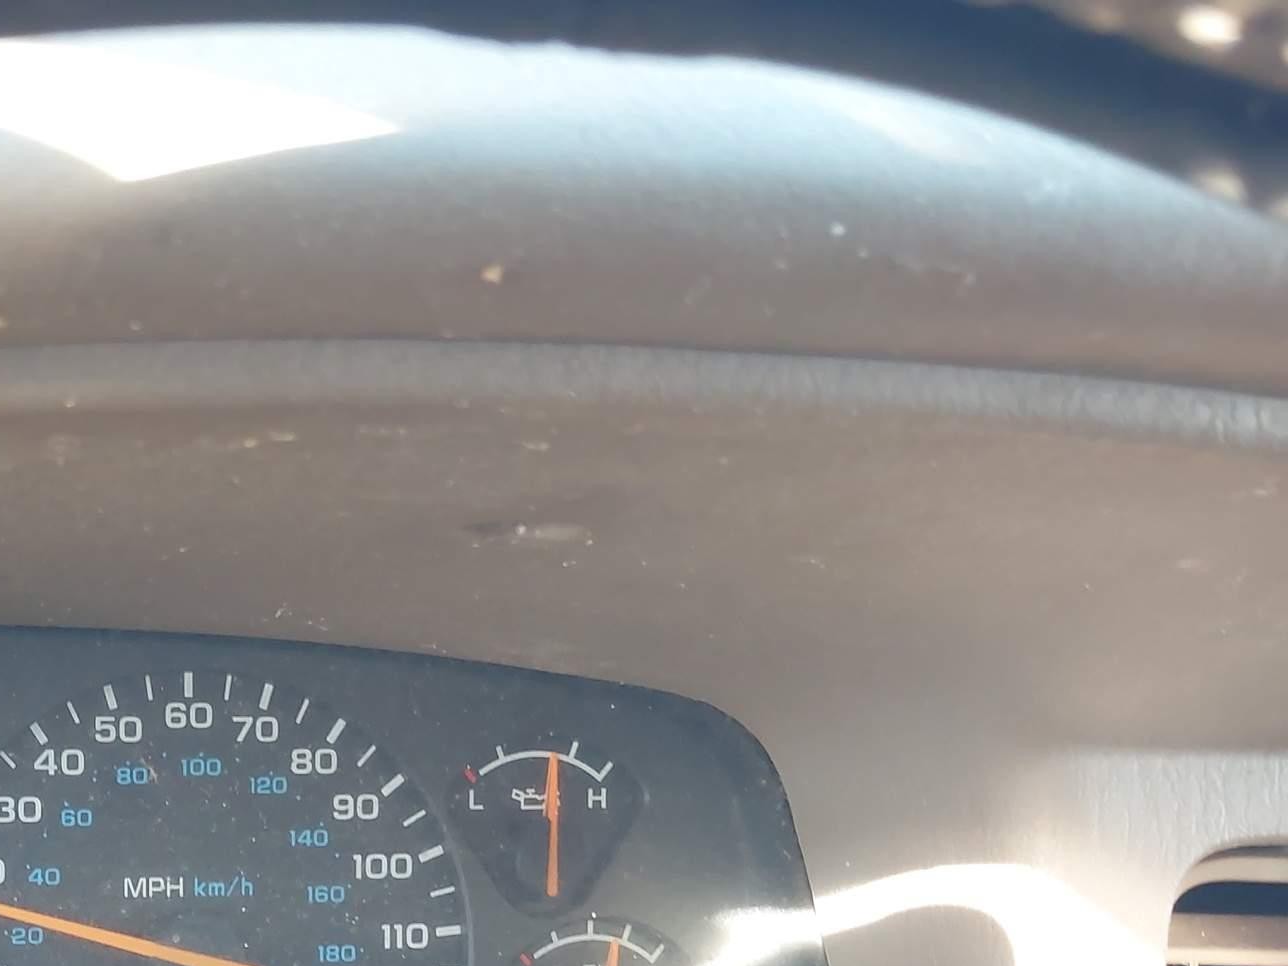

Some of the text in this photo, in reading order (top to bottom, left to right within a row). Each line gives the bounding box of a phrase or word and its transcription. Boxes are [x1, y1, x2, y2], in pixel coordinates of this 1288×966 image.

[164, 702, 212, 730] 60
[94, 716, 142, 744] 50
[232, 715, 279, 743] 70
[34, 749, 85, 777] 40
[180, 759, 222, 778] 100
[290, 749, 337, 778] 80
[116, 768, 149, 786] 80
[249, 777, 288, 795] 120
[333, 795, 379, 821] 90
[468, 788, 485, 812] L
[586, 787, 608, 810] H
[60, 810, 93, 828] 60
[289, 830, 329, 847] 140
[27, 867, 61, 886] 40
[353, 854, 413, 880] 100
[122, 874, 255, 900] MPH km/h
[307, 887, 345, 904] 160
[11, 928, 44, 946] 20
[381, 924, 428, 950] 110
[317, 945, 356, 963] 180
